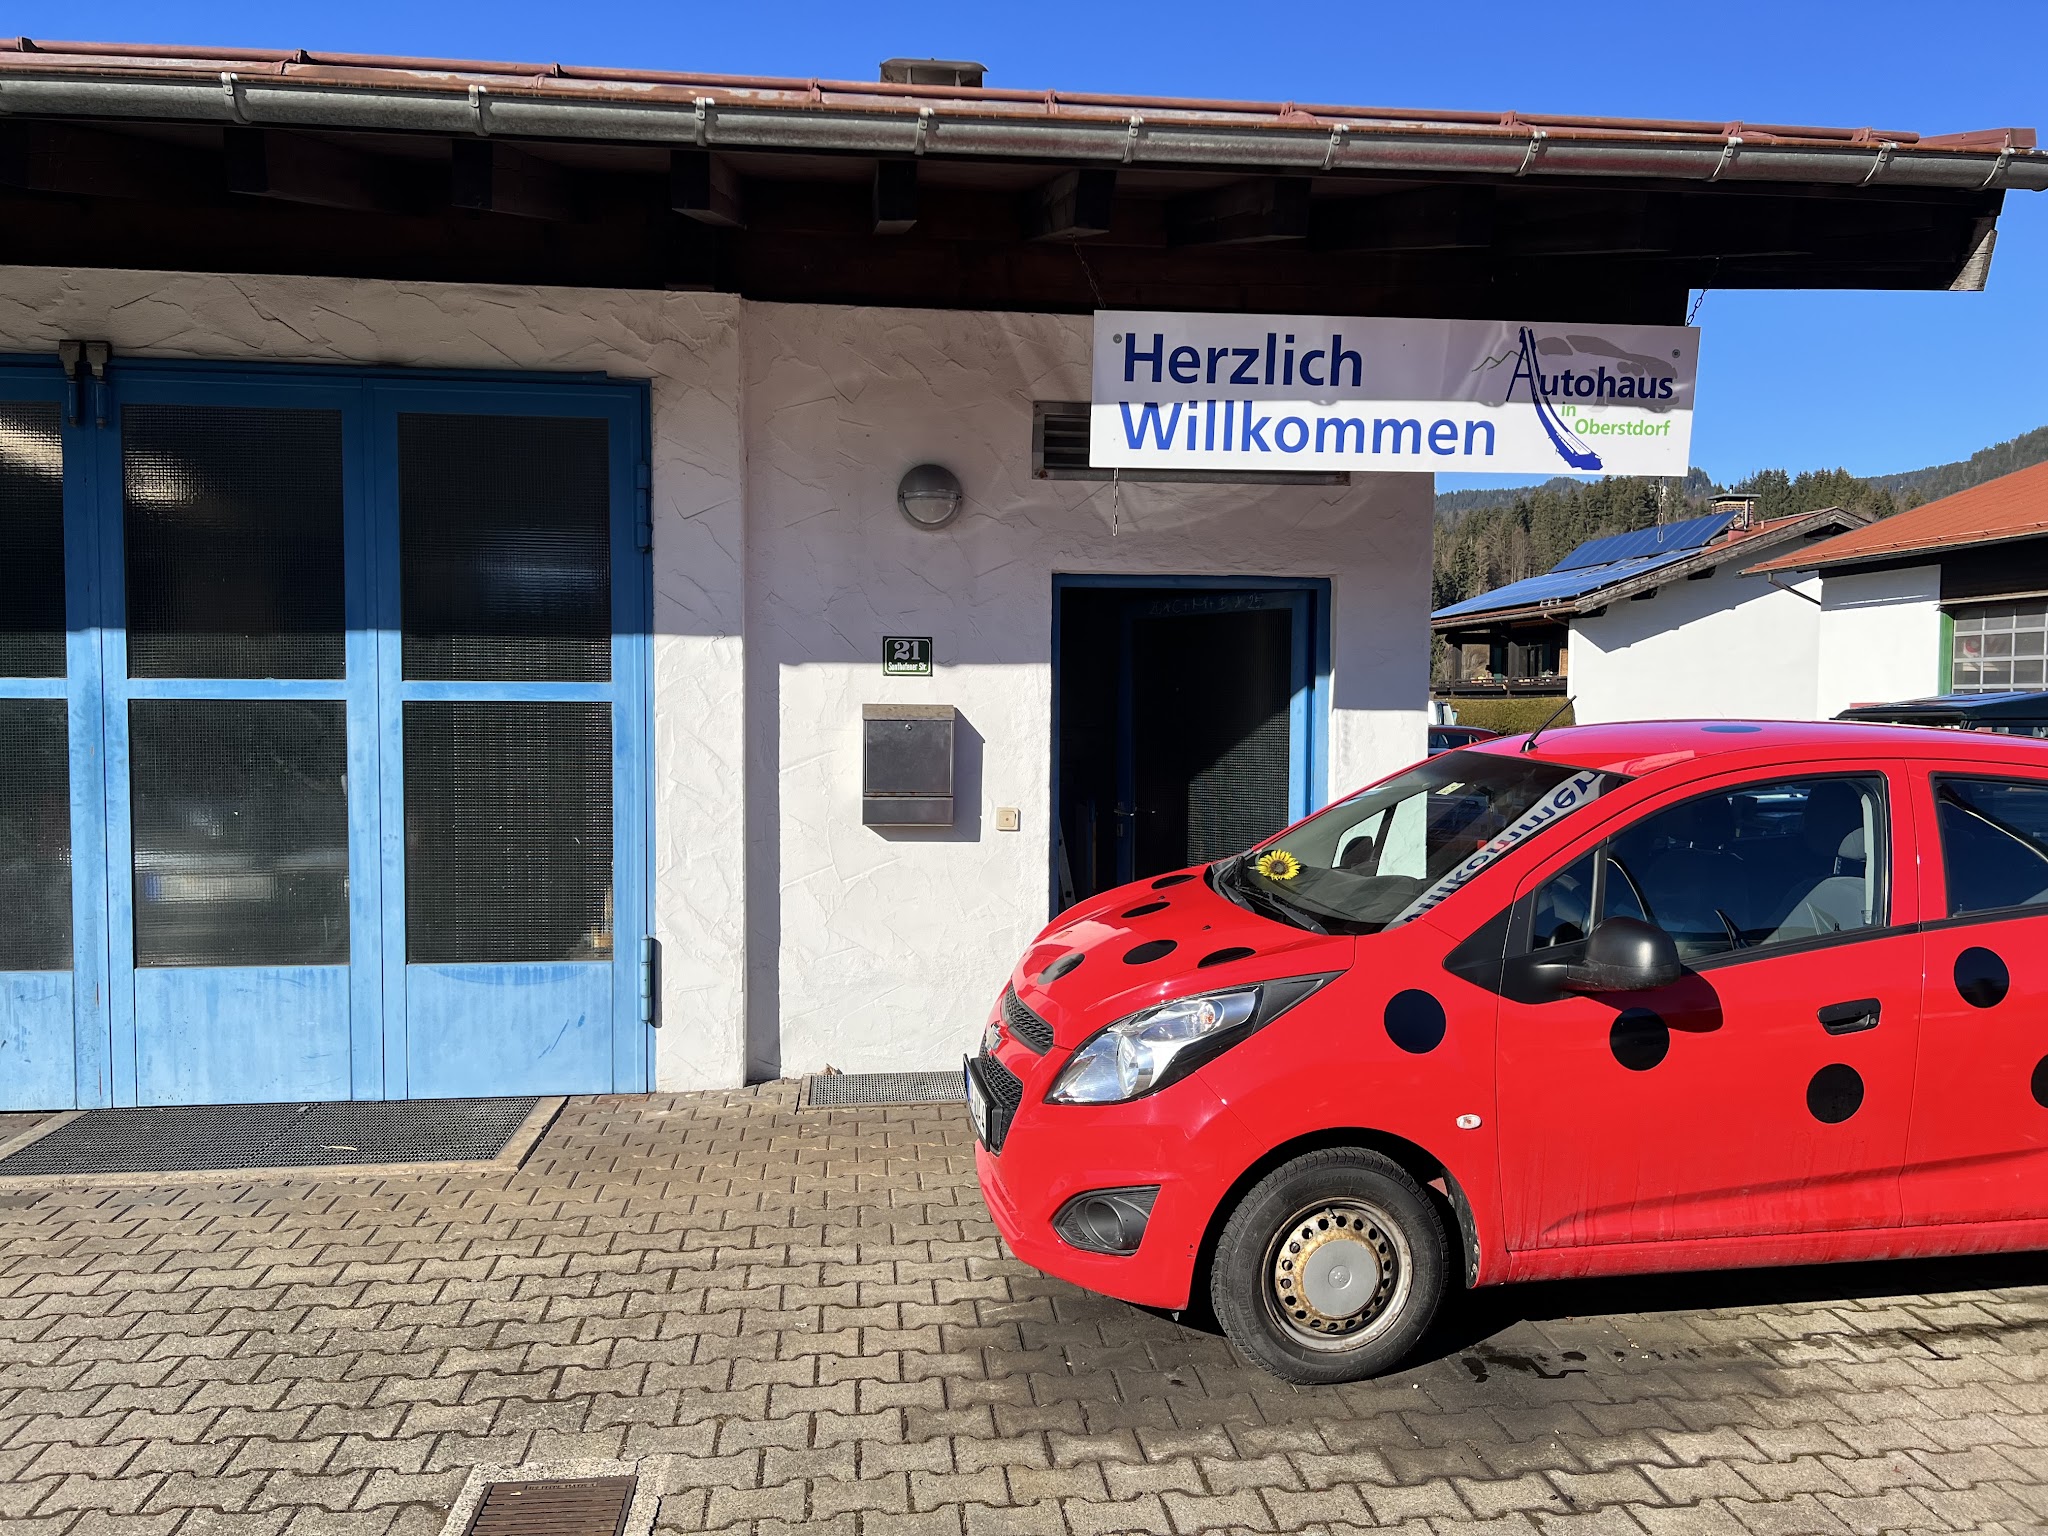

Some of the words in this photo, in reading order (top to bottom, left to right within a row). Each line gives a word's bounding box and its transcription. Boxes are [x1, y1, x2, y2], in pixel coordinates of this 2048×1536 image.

[1124, 332, 1363, 387] Herzlich
[1506, 327, 1673, 402] Autohaus
[1119, 399, 1495, 456] Willkommen
[1561, 401, 1577, 417] in
[1574, 418, 1671, 436] Oberstdorf
[893, 640, 921, 660] 21
